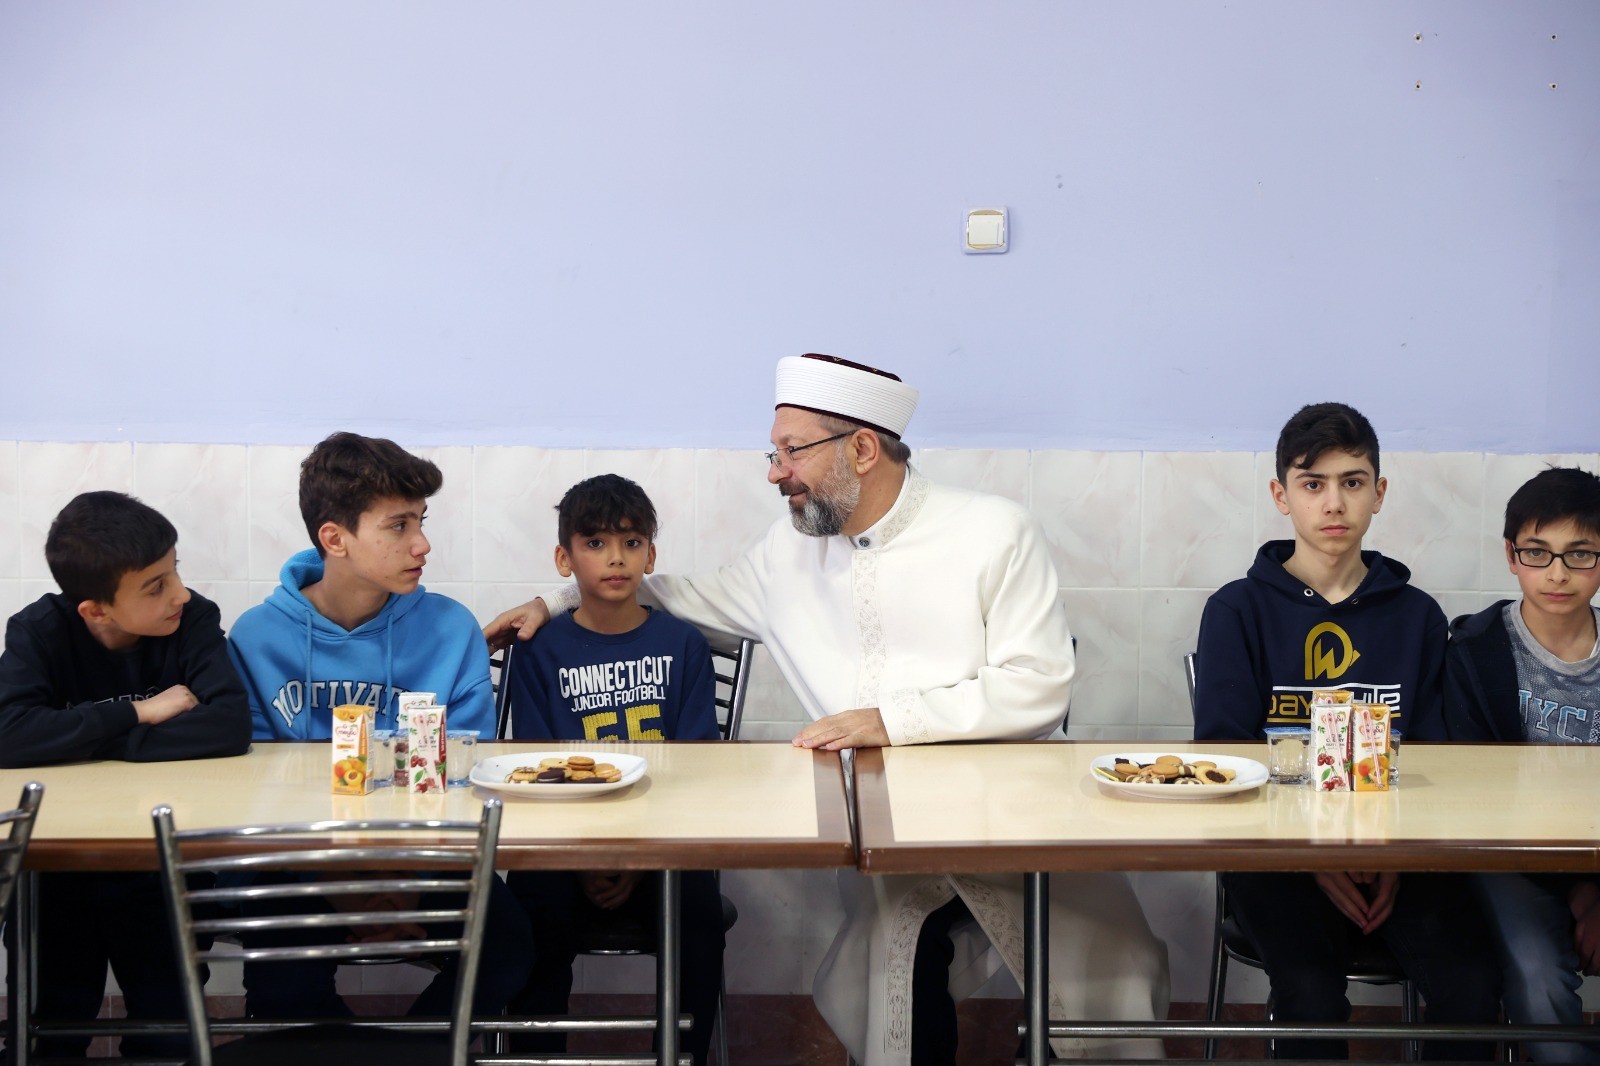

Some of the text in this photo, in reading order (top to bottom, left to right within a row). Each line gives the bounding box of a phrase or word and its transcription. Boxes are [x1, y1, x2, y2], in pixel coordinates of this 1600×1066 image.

[559, 655, 673, 698] CONNECTICUT
[272, 679, 404, 728] MOTIVAT
[571, 684, 666, 713] JUNIOR FOOTBALL
